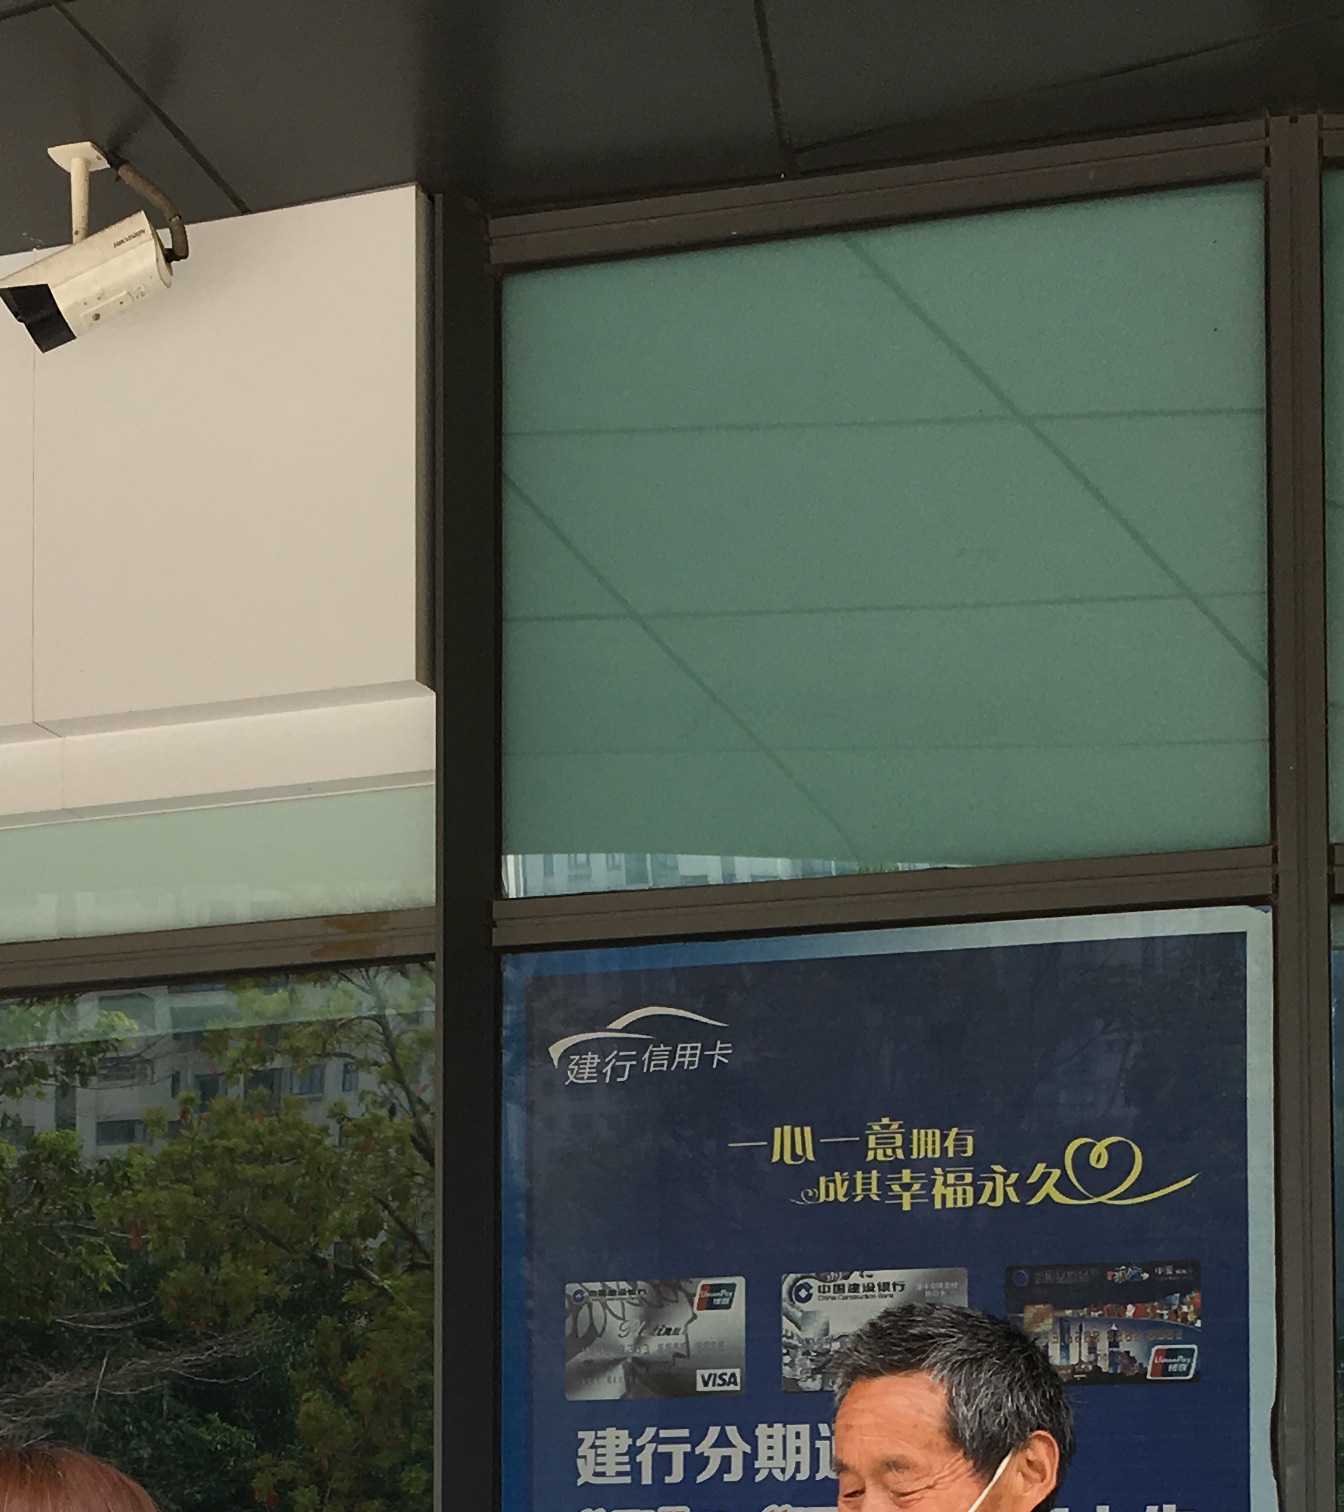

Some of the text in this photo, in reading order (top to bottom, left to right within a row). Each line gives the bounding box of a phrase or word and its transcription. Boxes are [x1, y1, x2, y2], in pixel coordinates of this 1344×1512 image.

[564, 1040, 735, 1086] 建行信用卡
[728, 1116, 975, 1166] 一心一意拥有
[816, 1162, 1066, 1212] 成其幸福永久
[817, 1281, 906, 1295] 中国建设银行
[700, 1372, 739, 1388] VISA
